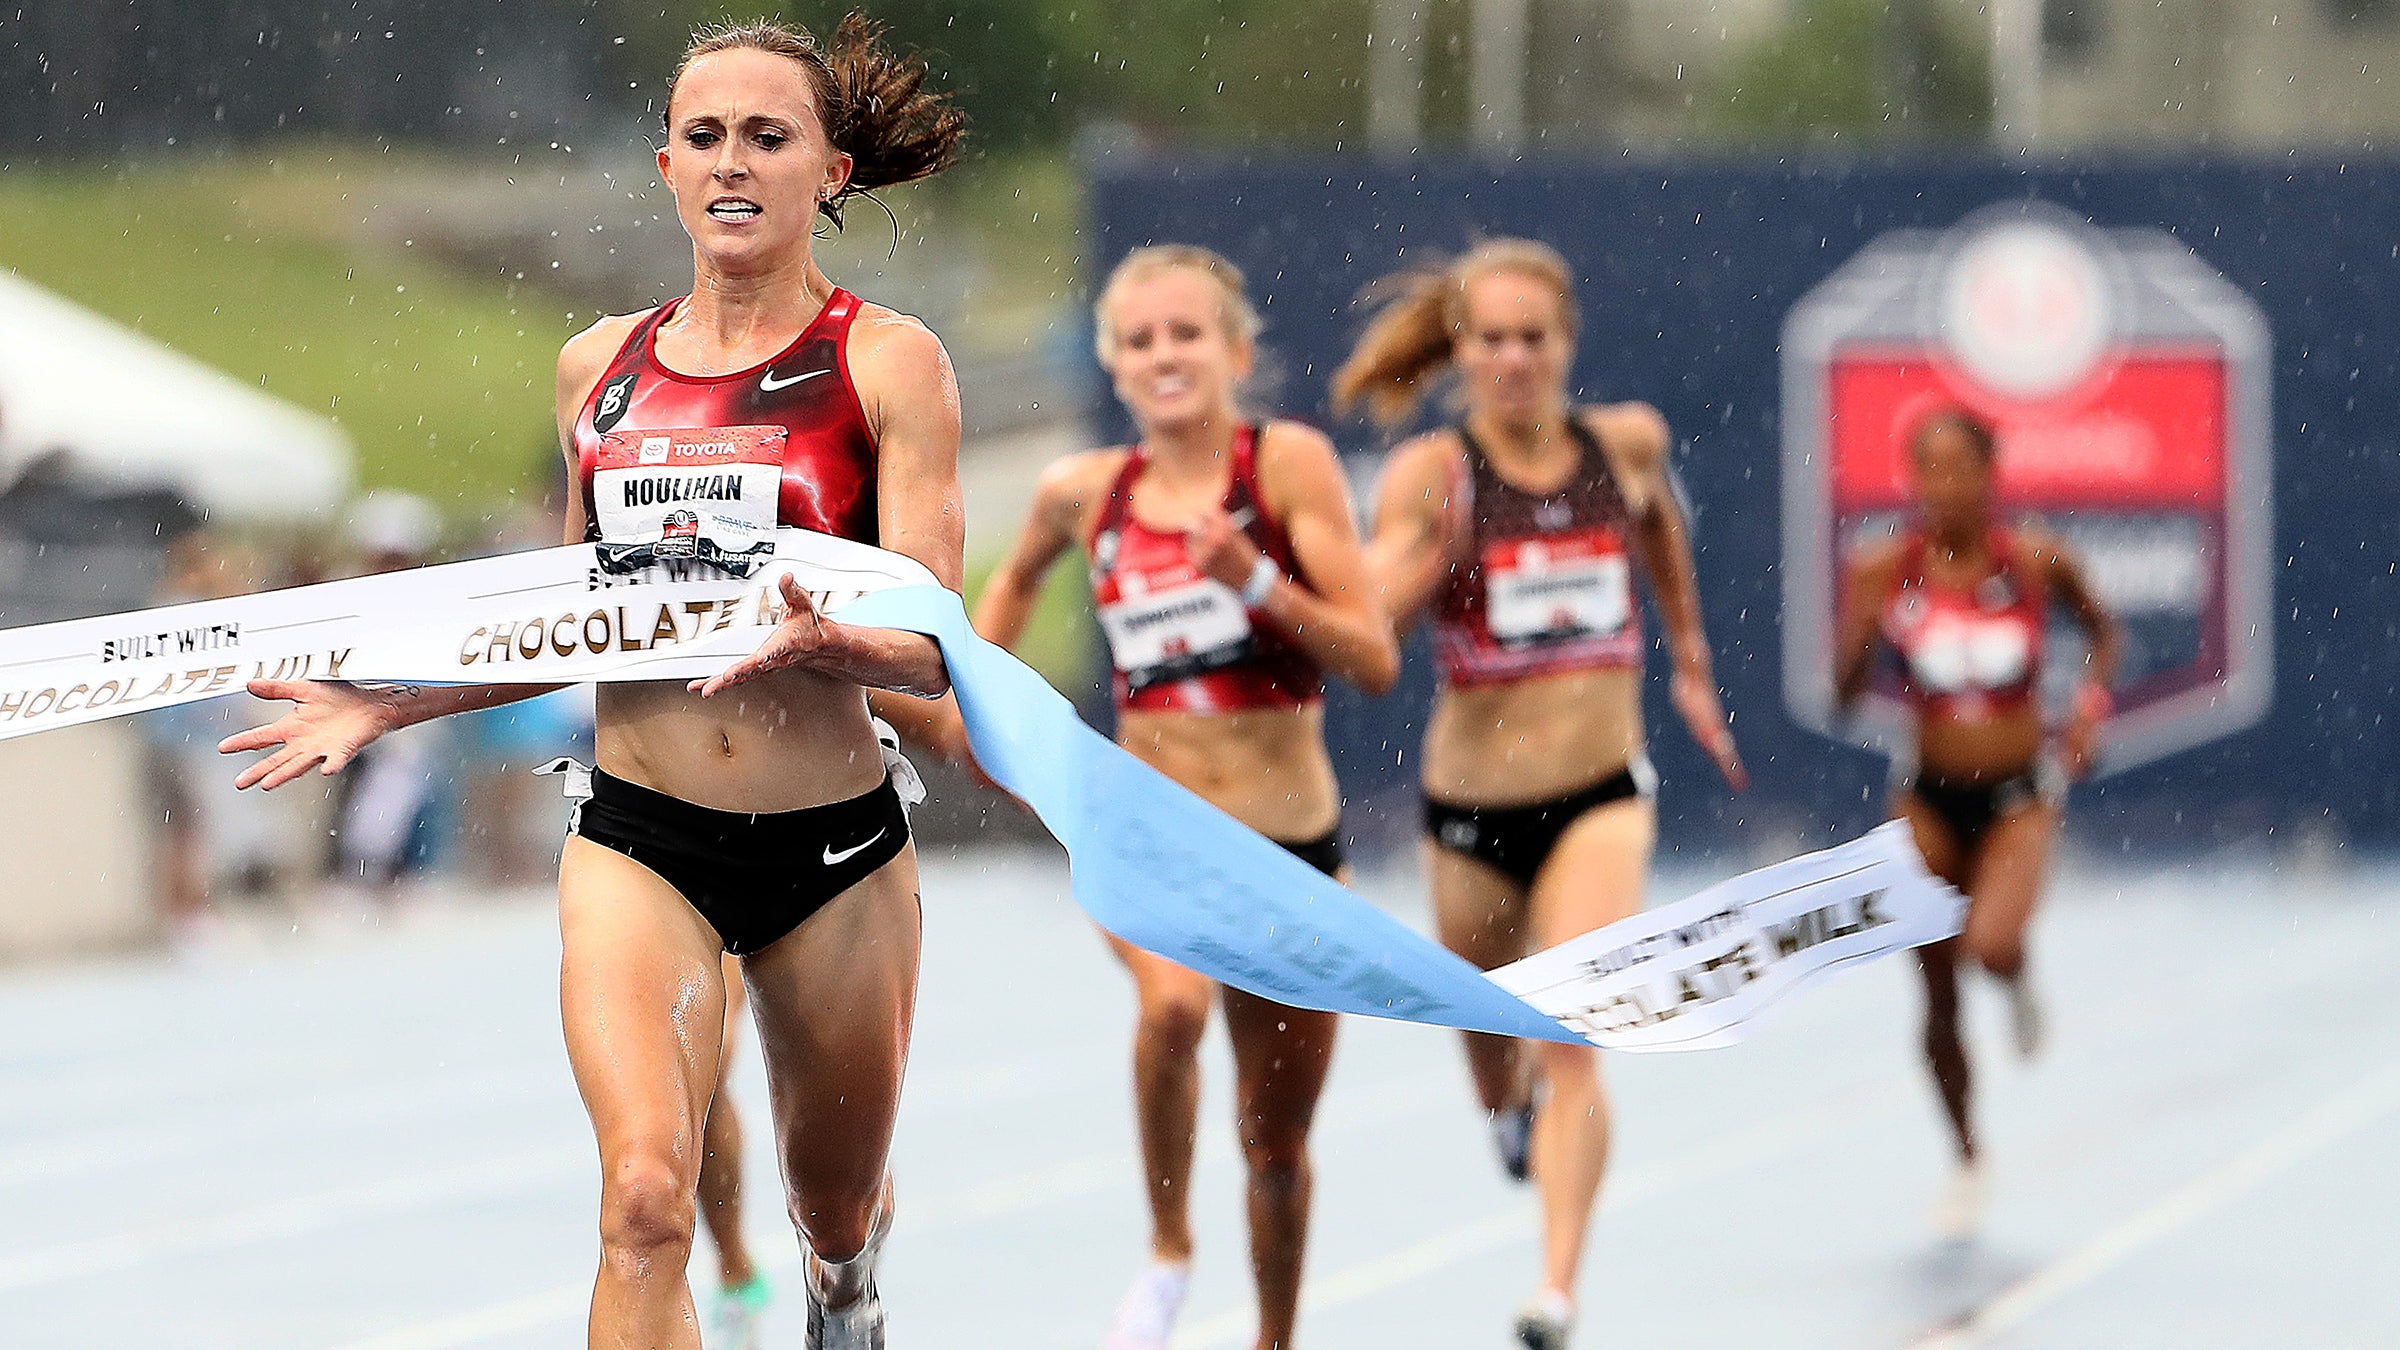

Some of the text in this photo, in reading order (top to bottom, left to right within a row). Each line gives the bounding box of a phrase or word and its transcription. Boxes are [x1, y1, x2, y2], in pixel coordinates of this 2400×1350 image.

[674, 442, 736, 456] TOYOTA
[624, 475, 742, 507] HOULIHAN
[101, 622, 241, 663] BUILT WITH
[459, 598, 742, 666] CHOCOLATE
[1763, 885, 1898, 959] MILK
